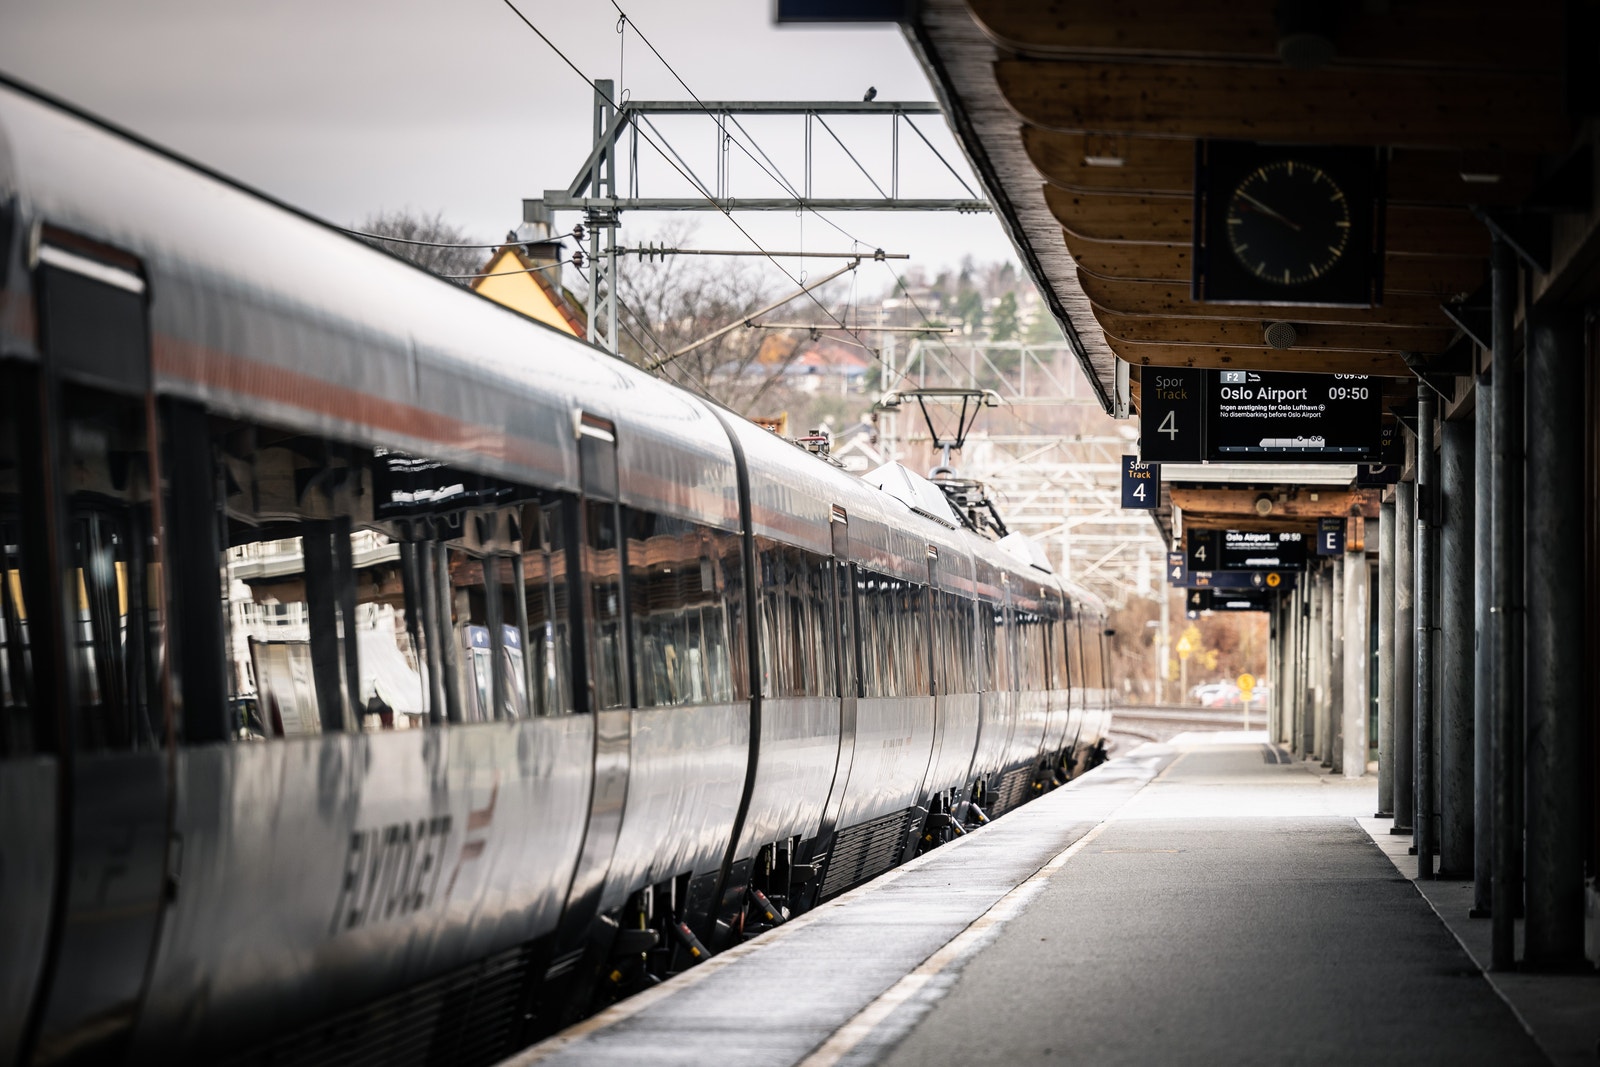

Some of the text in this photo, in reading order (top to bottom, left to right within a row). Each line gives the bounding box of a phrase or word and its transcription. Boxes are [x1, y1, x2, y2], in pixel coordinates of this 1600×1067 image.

[1155, 375, 1184, 388] Spor
[1227, 373, 1239, 382] F2
[1155, 388, 1188, 400] Track
[1220, 386, 1307, 403] Oslo Airport
[1328, 386, 1369, 400] 09:50
[1229, 411, 1268, 419] disembarking
[1301, 411, 1321, 419] Airport
[1157, 410, 1179, 441] 4
[1130, 461, 1150, 471] Spor
[1128, 470, 1151, 479] Track
[1132, 482, 1146, 502] 4
[1226, 533, 1271, 543] Oslo Airport
[1326, 532, 1337, 550] E
[1194, 545, 1207, 562] 4
[1171, 566, 1182, 580] 4
[1191, 592, 1201, 605] 4
